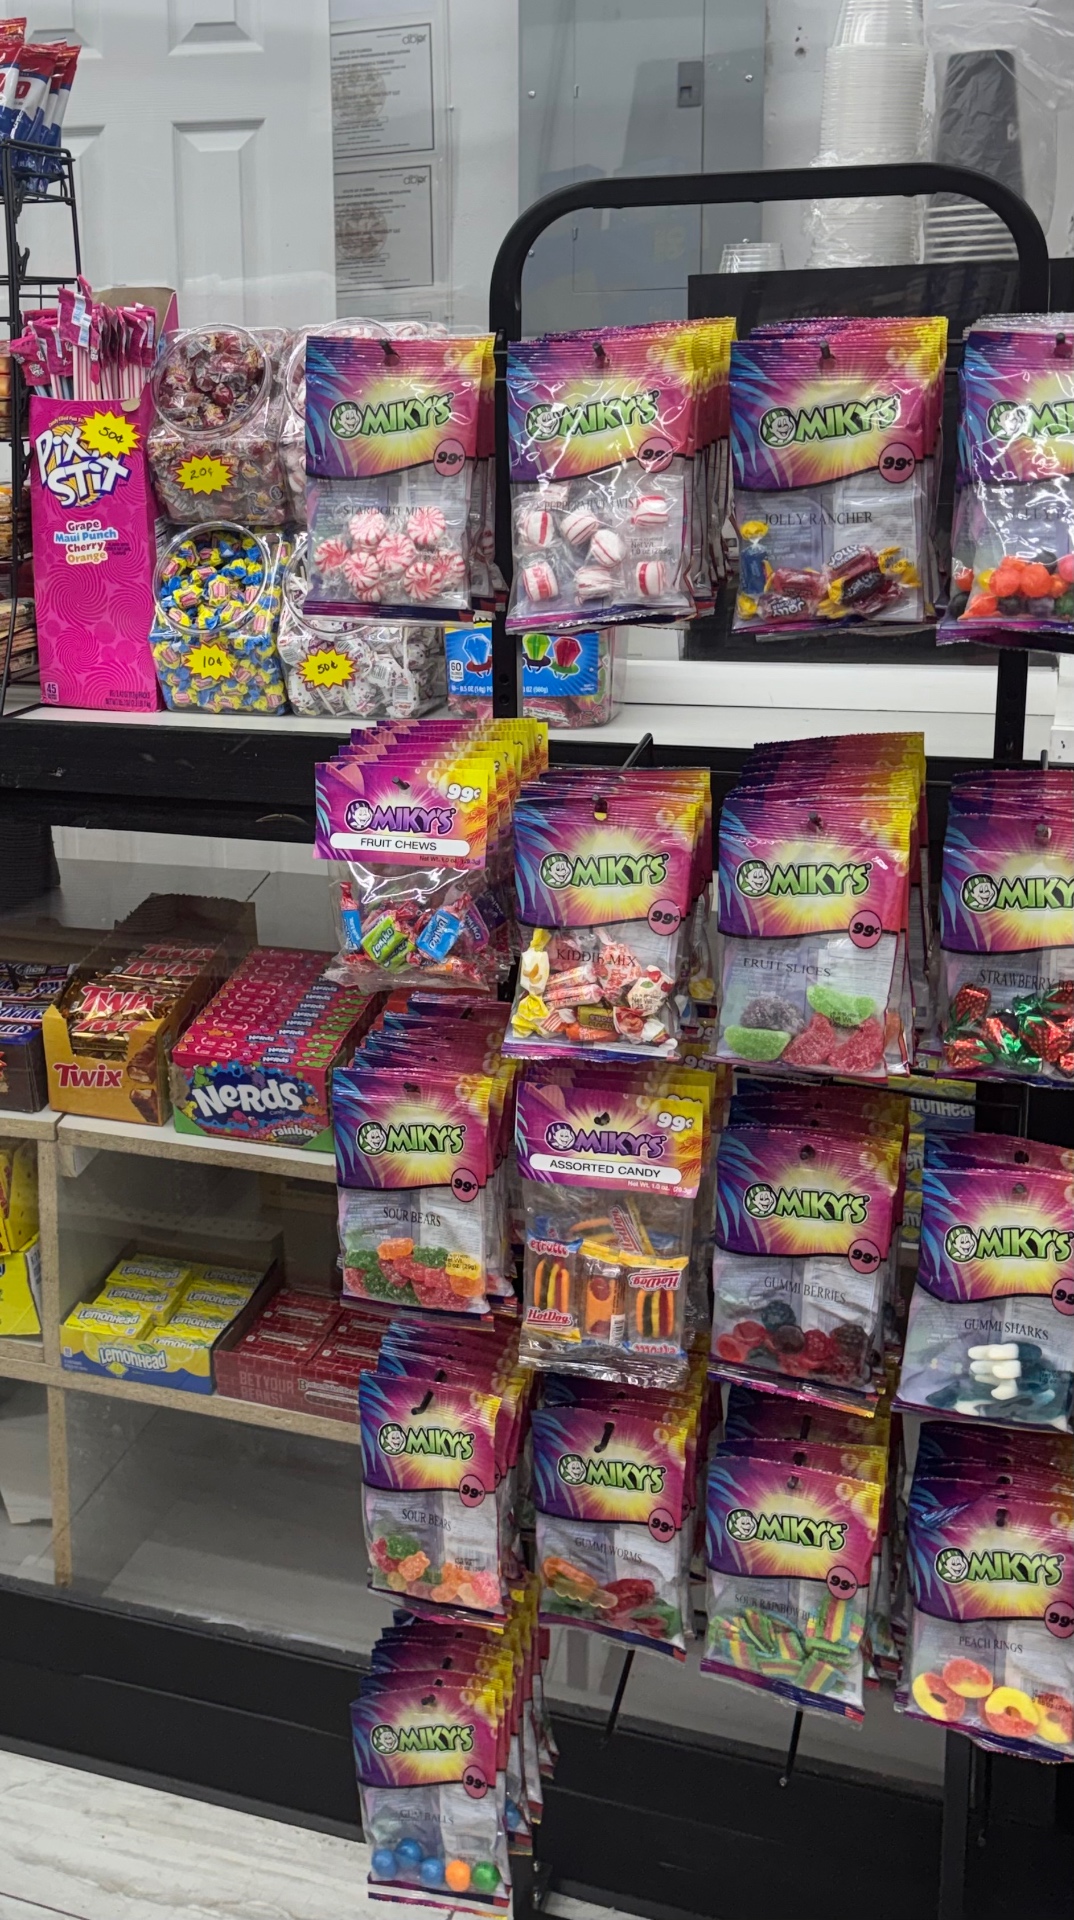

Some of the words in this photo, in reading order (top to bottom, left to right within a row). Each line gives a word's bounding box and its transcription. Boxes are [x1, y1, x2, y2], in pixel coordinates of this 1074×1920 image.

[361, 393, 453, 434] MIKY'S
[558, 391, 659, 436] MIKY'S
[796, 395, 900, 442] MIKY'S
[881, 456, 912, 471] 99¢
[67, 521, 100, 532] Grape
[764, 513, 806, 525] JOLLY
[810, 511, 873, 525] RANCHER
[55, 533, 80, 542] Maui
[82, 529, 117, 540] Punch
[67, 542, 104, 553] Cherry
[67, 552, 107, 563] Orange
[450, 662, 462, 672] 60
[46, 683, 57, 694] 45
[447, 783, 481, 803] 99¢
[371, 806, 455, 834] MIKY'S
[360, 838, 392, 849] FRUIT
[395, 840, 437, 851] CHEWS
[572, 854, 668, 885] MIKY'S
[770, 863, 871, 896] MIKY'S
[651, 910, 679, 925] 99¢
[852, 921, 880, 937] 99¢
[743, 957, 783, 972] FRUIT
[786, 962, 832, 977] SLICES
[980, 969, 1055, 990] STRAWBERRY
[81, 984, 165, 1015] Twix
[54, 1062, 123, 1088] Twix
[657, 1112, 694, 1133] 99¢
[386, 1125, 466, 1153] MIKY'S
[573, 1130, 667, 1159] MIKY'S
[549, 1159, 615, 1175] ASSORTED
[617, 1166, 662, 1178] CANDY
[453, 1178, 477, 1193] 99¢
[628, 1180, 638, 1188] Net
[776, 1187, 870, 1223] MIKY'S
[383, 1206, 410, 1222] SOUR
[411, 1211, 441, 1227] BEARS
[975, 1229, 1074, 1261] MIKY'S
[851, 1248, 878, 1264] 99¢
[764, 1275, 801, 1296] GUMMI
[803, 1283, 847, 1304] BERRIES
[528, 1309, 570, 1325] HotDog
[963, 1317, 1003, 1333] GUMMI
[1004, 1321, 1049, 1341] SHARKS
[239, 1371, 260, 1388] BET
[262, 1376, 294, 1394] YOUR
[405, 1427, 474, 1460] MIKY'S
[586, 1461, 666, 1493] MIKY'S
[461, 1484, 483, 1499] 99¢
[402, 1509, 428, 1523] SOUR
[428, 1513, 452, 1532] BEARS
[650, 1517, 673, 1533] 99¢
[757, 1514, 847, 1551] MIKY'S
[575, 1537, 607, 1553] GUMMI
[609, 1546, 642, 1563] WORMS
[968, 1551, 1064, 1587] MIKY'S
[829, 1574, 856, 1591] 99¢
[959, 1635, 991, 1650] PEACH
[993, 1639, 1023, 1655] RINGS
[398, 1725, 475, 1752] MIKY'S
